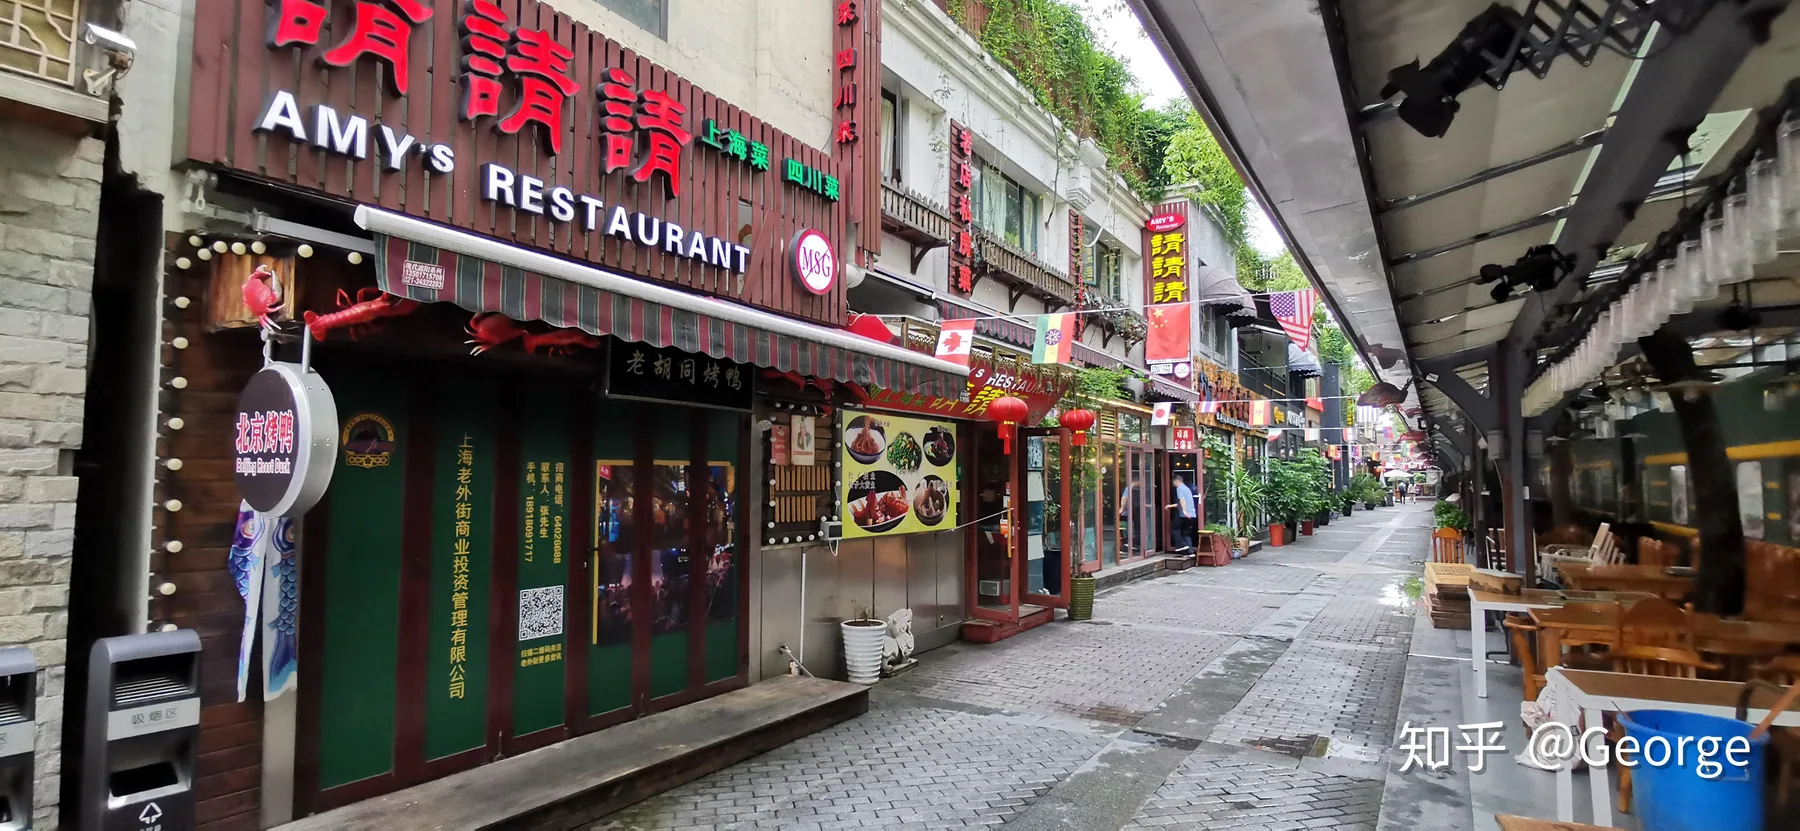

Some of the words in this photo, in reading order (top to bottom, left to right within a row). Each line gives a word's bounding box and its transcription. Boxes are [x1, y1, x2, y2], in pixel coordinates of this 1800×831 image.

[702, 119, 770, 171] 上海菜
[787, 158, 840, 202] 四川菜
[488, 163, 751, 275] RESTAURANT
[802, 246, 831, 277] MSG
[1151, 233, 1188, 304] 請請請
[626, 350, 742, 391] 老胡同烤鸭
[236, 410, 293, 454] 北京烤鸭
[236, 457, 256, 476] Beijing
[449, 432, 474, 700] 上海老外街商业投资管理有限公司
[131, 707, 178, 725] 吸烟区
